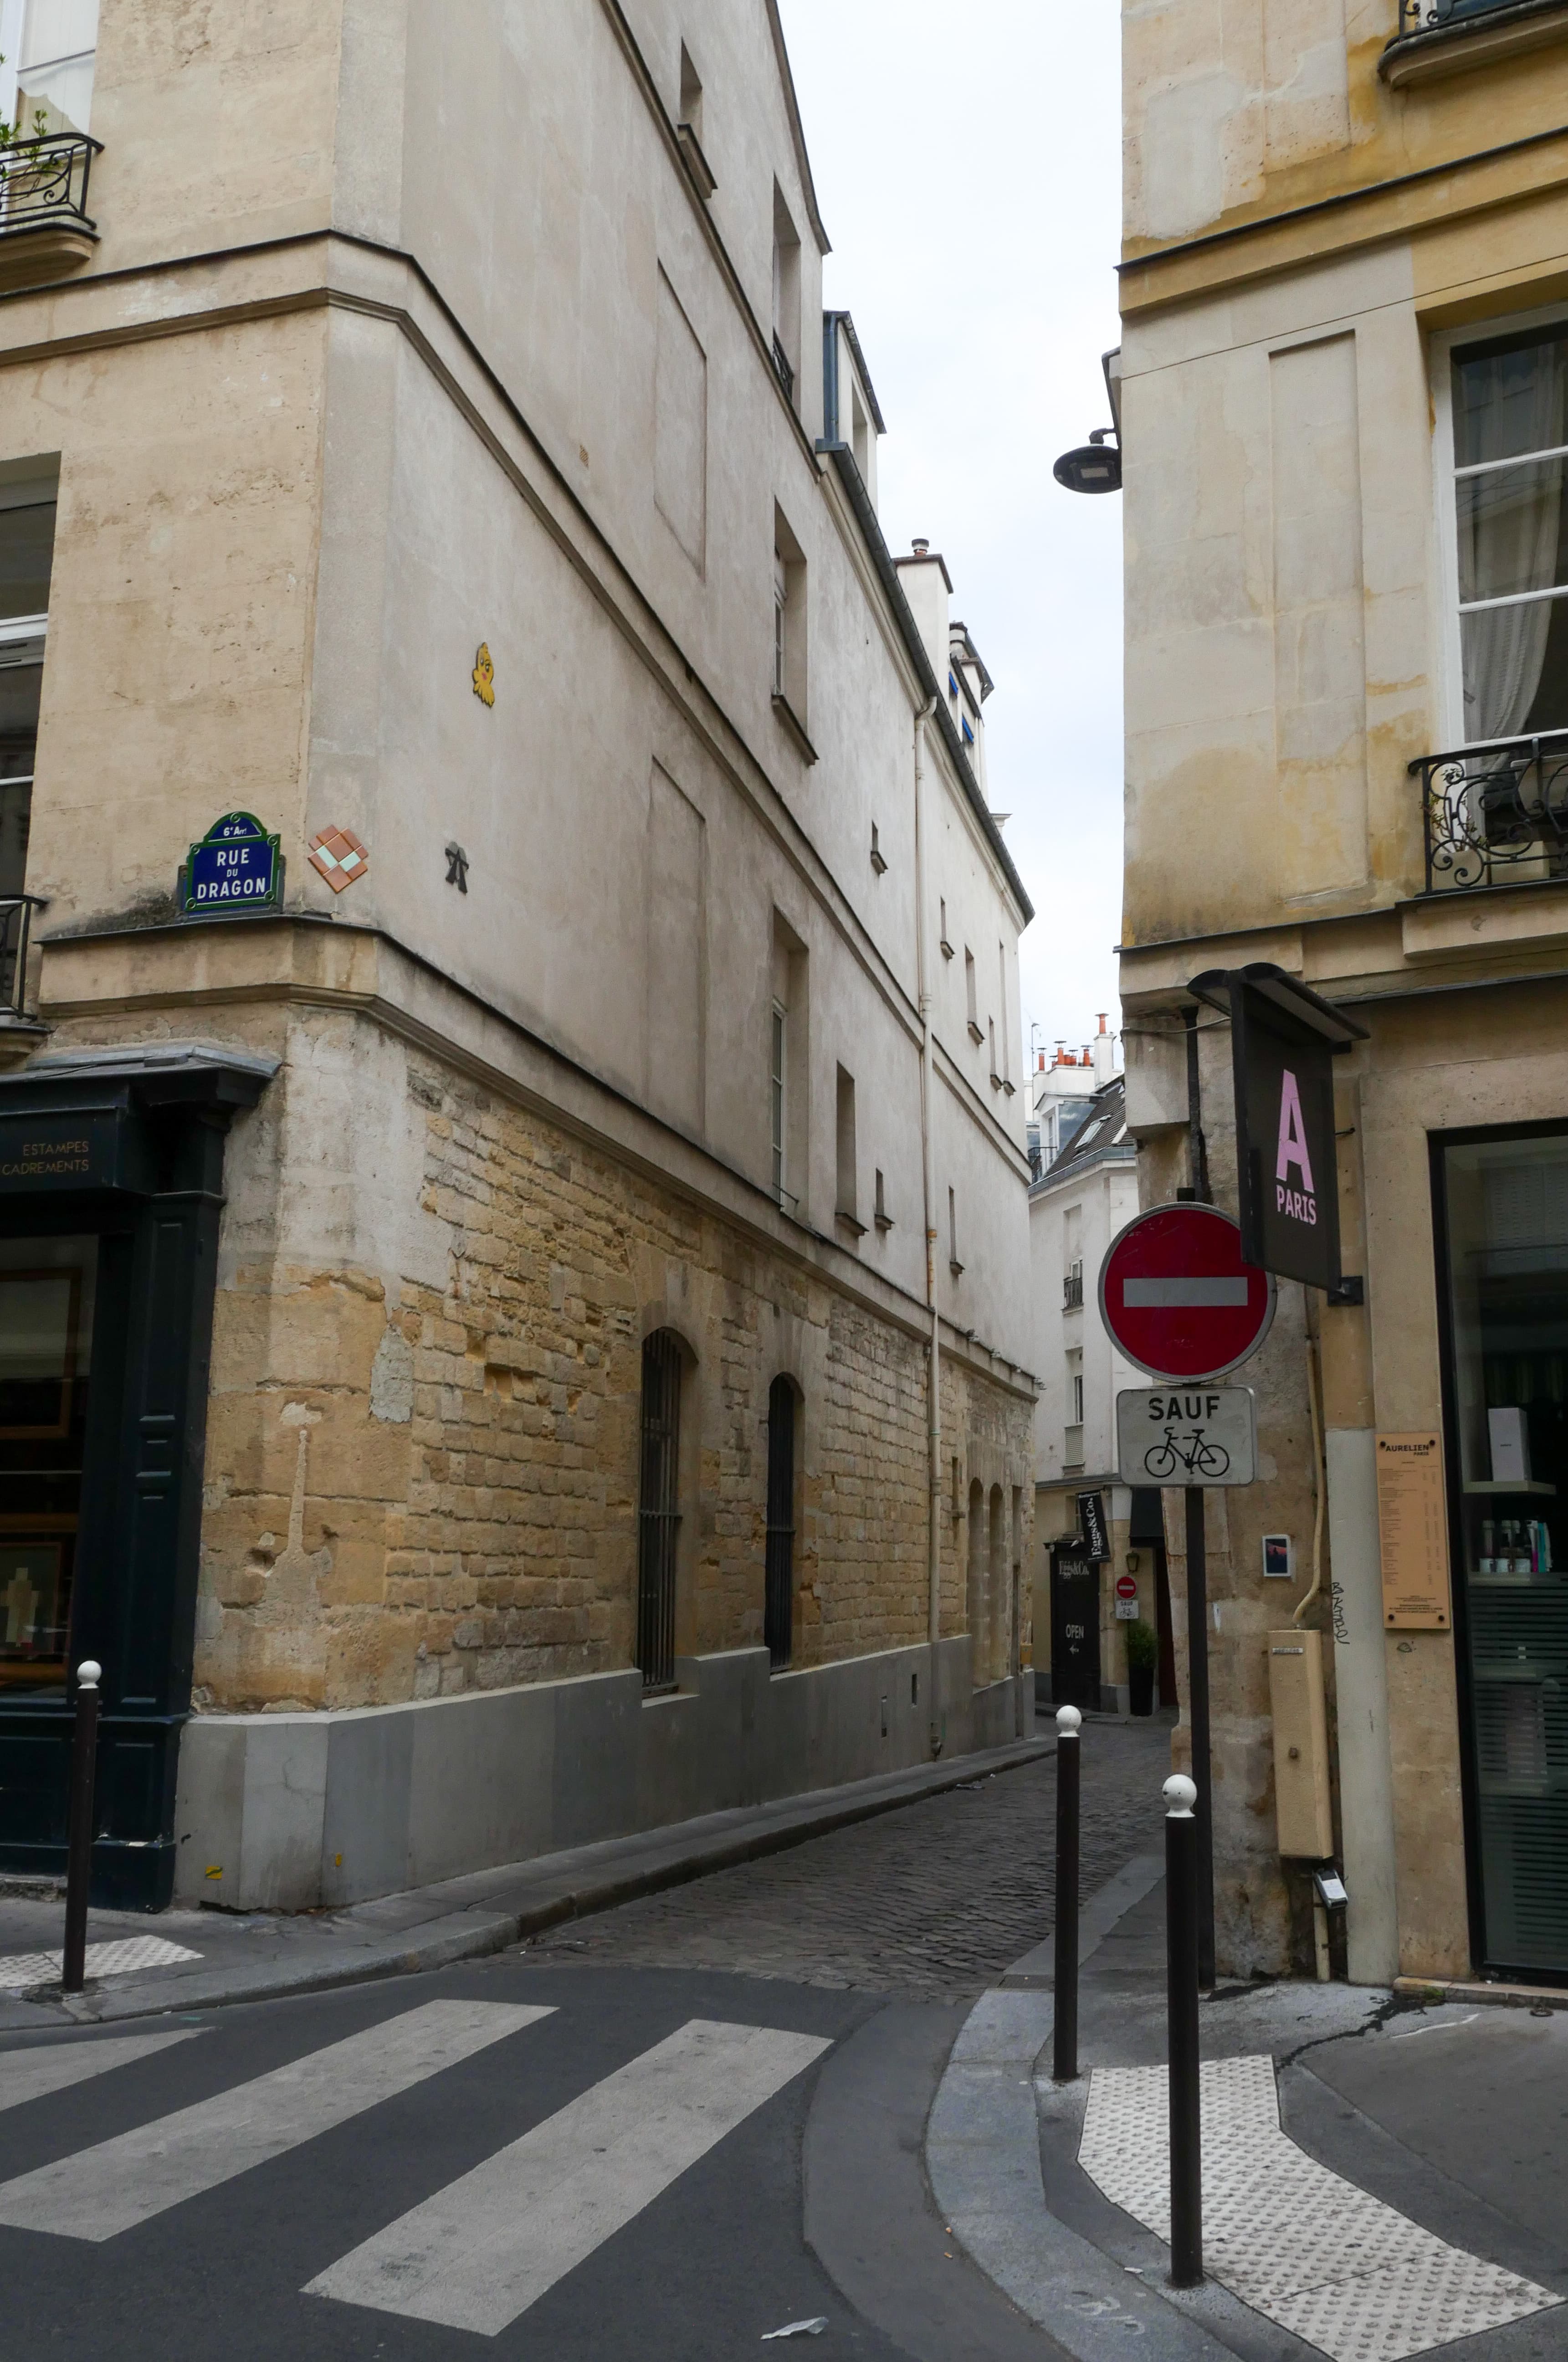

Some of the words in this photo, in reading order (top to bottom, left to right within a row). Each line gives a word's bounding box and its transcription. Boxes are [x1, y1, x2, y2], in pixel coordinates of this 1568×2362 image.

[217, 848, 250, 867] RUE
[226, 868, 238, 878] DU
[197, 877, 266, 899] DRAGON
[1276, 1069, 1314, 1194] A
[23, 1141, 89, 1156] ESTAMPES
[2, 1160, 89, 1176] CADREMENTS
[1276, 1185, 1317, 1225] PARIS
[1148, 1396, 1220, 1421] SAUF
[1086, 1497, 1103, 1556] Eggs&Co.
[1066, 1624, 1084, 1639] OPEN
